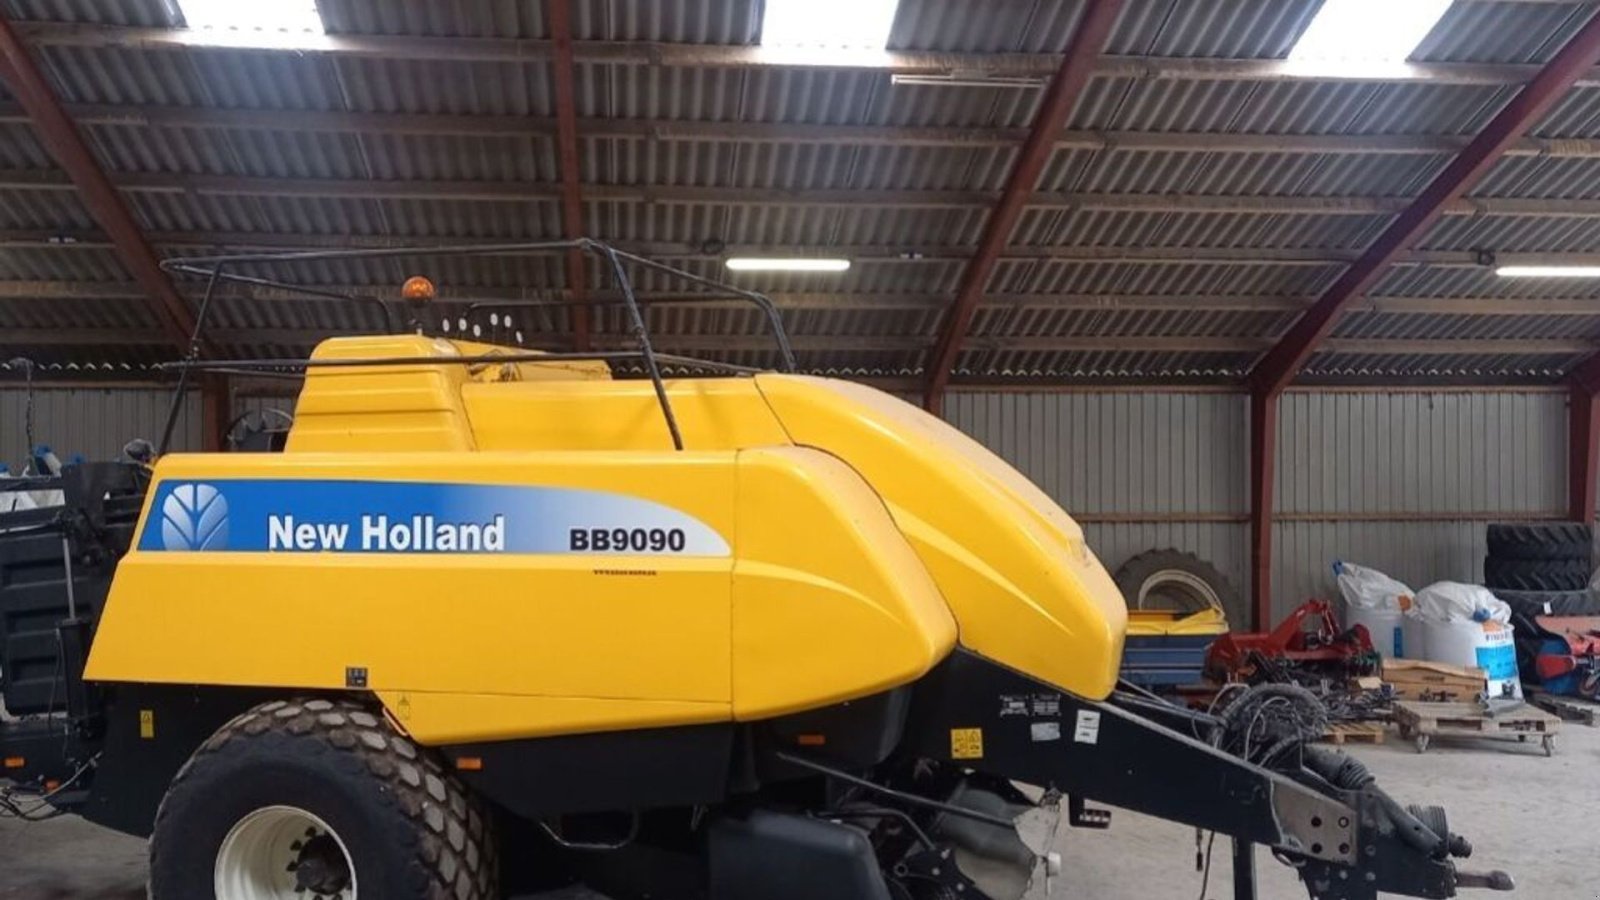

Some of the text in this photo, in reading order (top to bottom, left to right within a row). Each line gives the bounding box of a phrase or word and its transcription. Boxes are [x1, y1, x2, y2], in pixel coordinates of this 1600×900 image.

[268, 514, 505, 551] New Holland
[569, 527, 686, 552] BB9090
